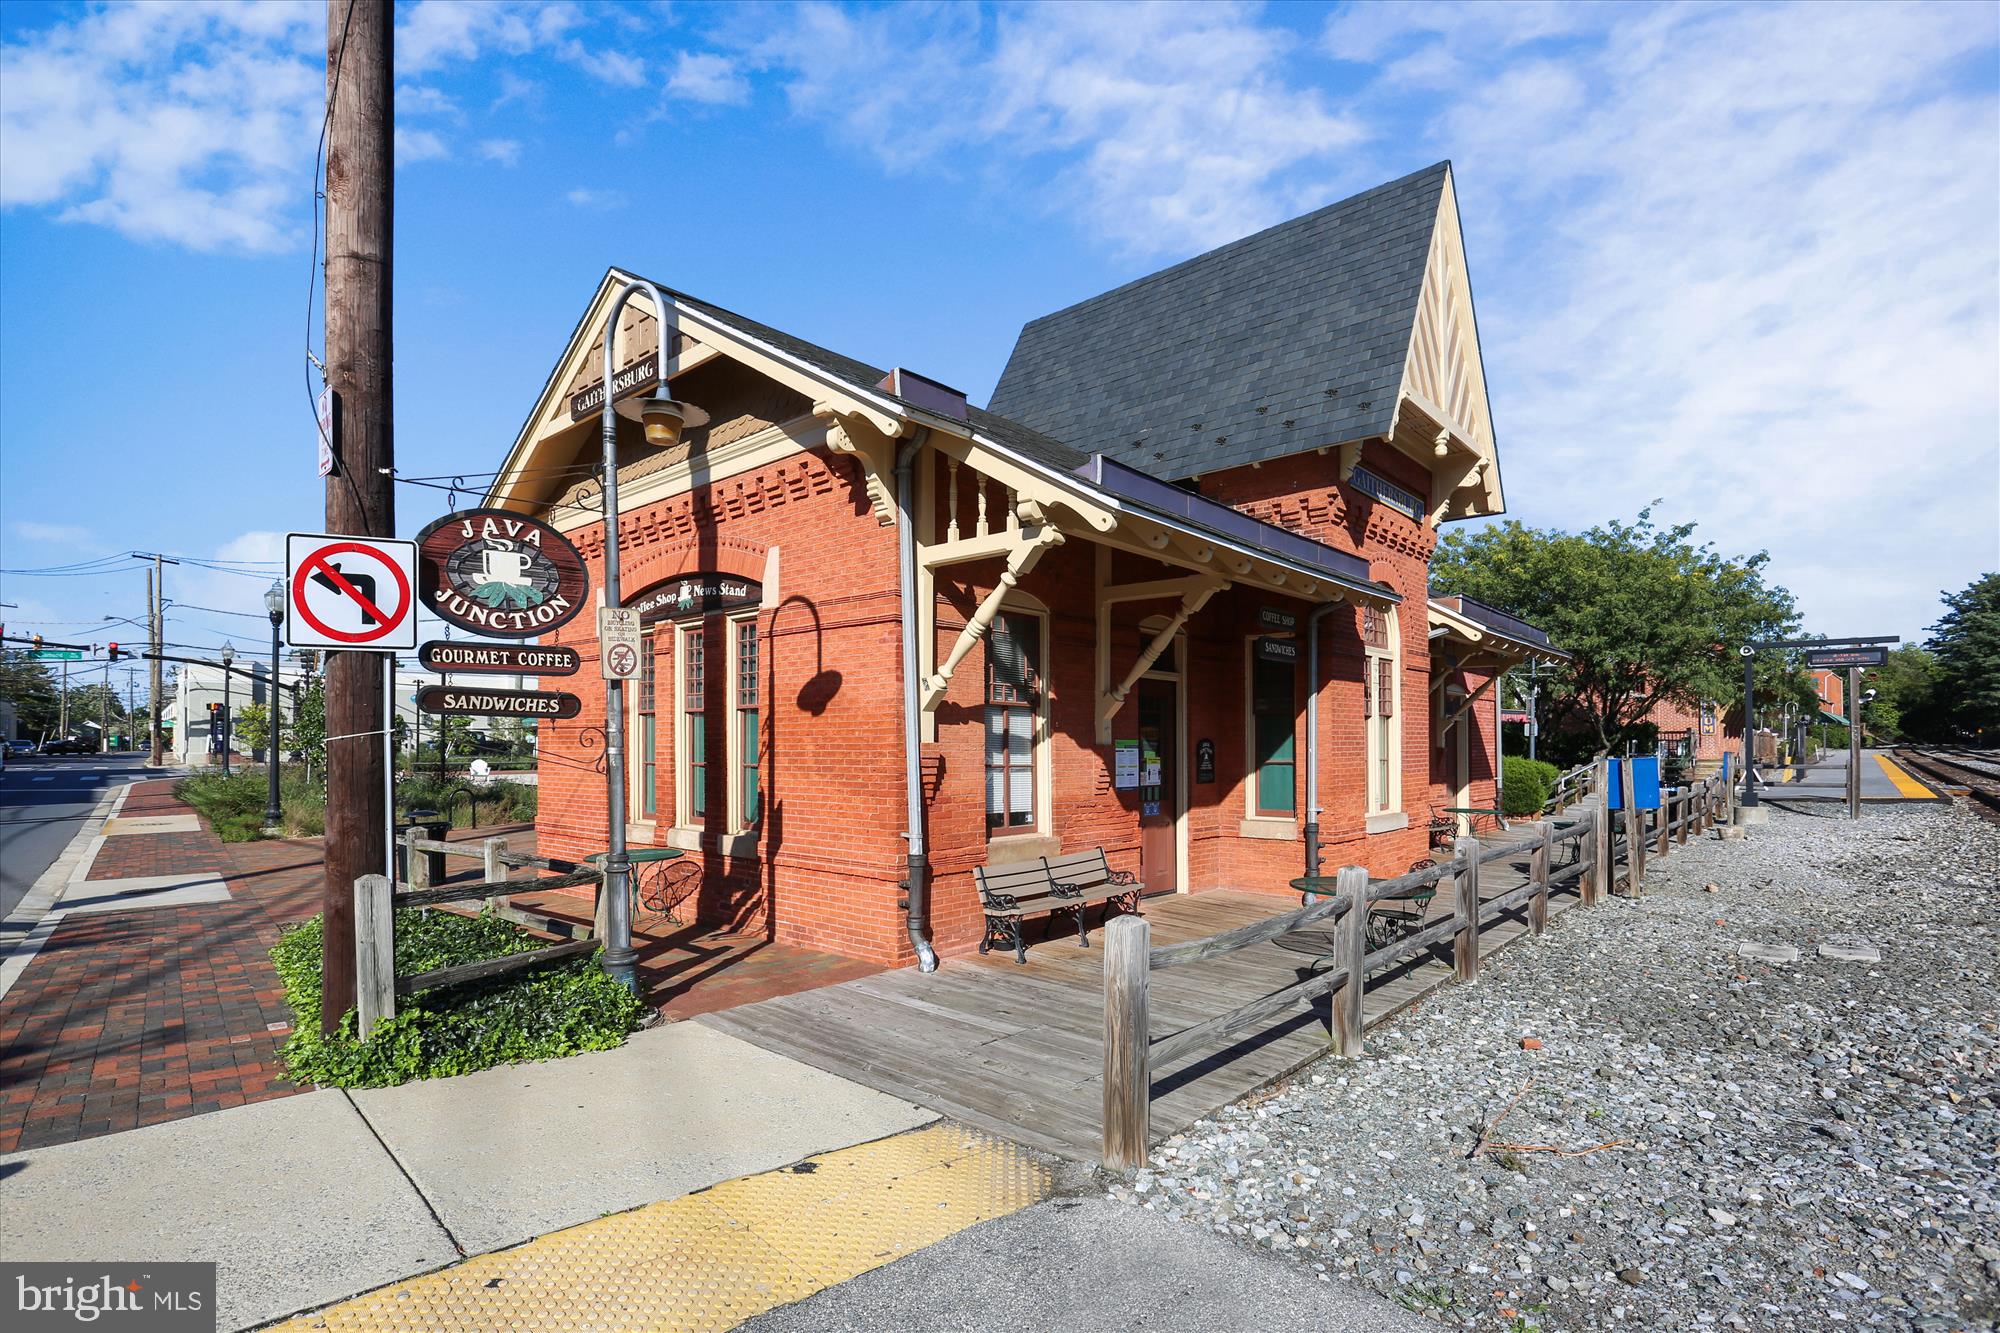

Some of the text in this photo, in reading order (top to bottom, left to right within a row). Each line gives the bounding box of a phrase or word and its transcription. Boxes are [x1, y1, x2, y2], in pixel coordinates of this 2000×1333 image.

[577, 361, 654, 412] GAITHRSBURG
[1353, 468, 1423, 518] GAITHERSBURG
[461, 517, 542, 548] JAVA
[435, 588, 571, 629] JUNCTION
[631, 582, 747, 613] ffee Shop News Stand
[612, 610, 630, 620] NO
[1262, 610, 1296, 626] COFFEE SHOP
[430, 648, 573, 668] GOURMET COFFEE
[1265, 641, 1296, 657] SANDWICHES
[443, 693, 560, 713] SANDWICHES
